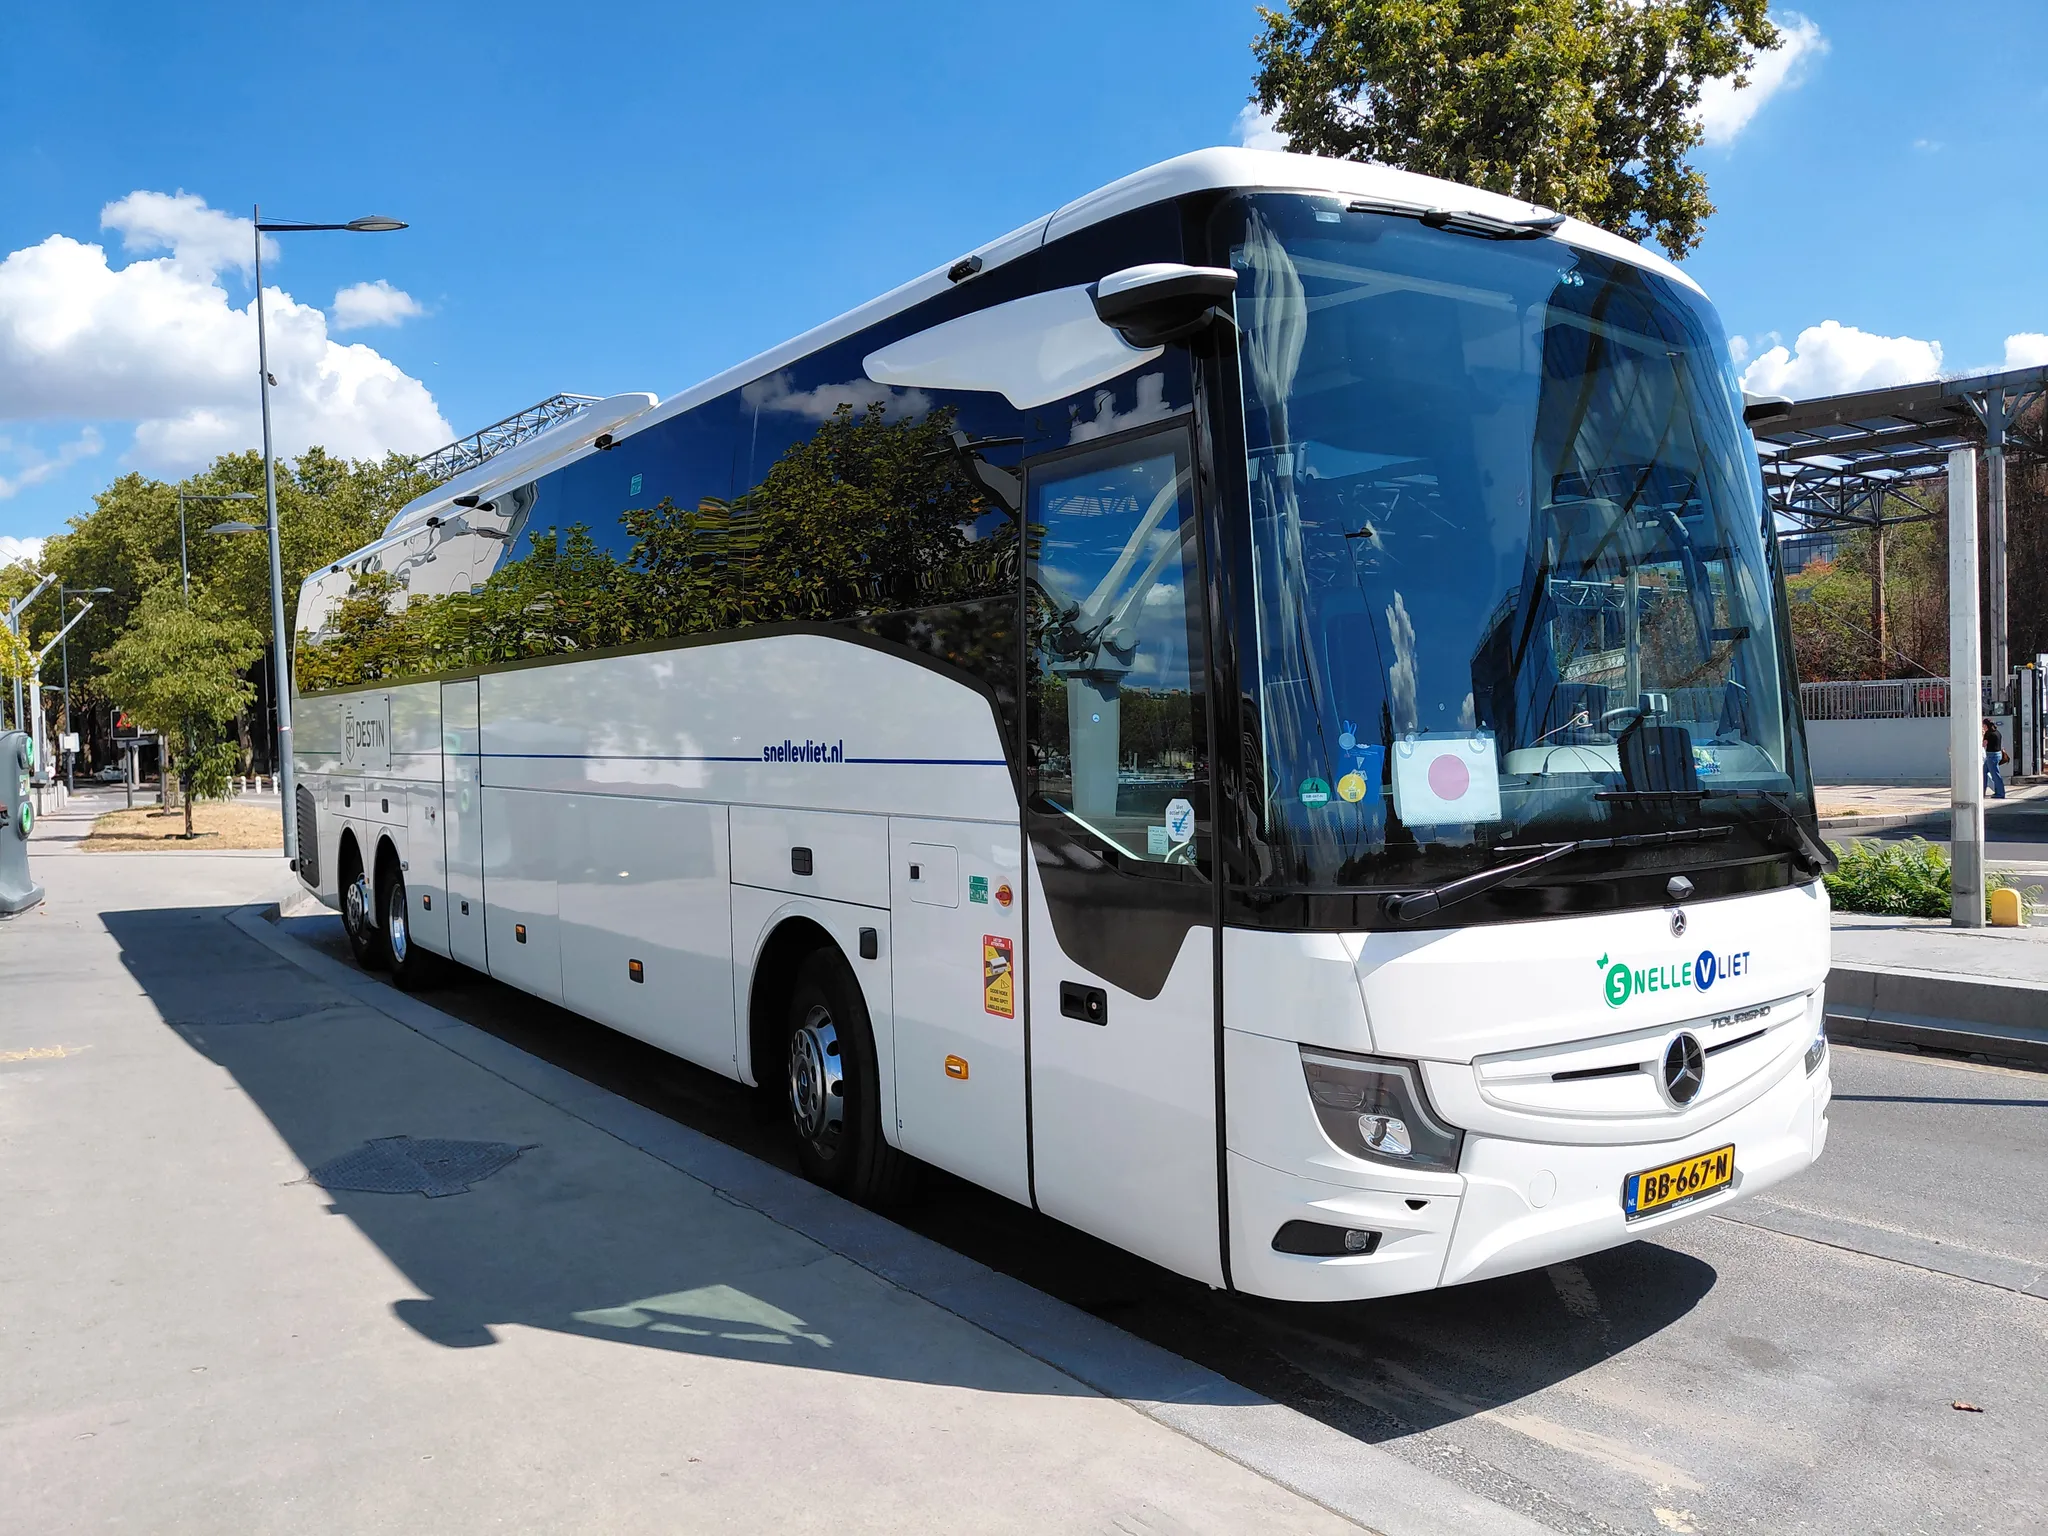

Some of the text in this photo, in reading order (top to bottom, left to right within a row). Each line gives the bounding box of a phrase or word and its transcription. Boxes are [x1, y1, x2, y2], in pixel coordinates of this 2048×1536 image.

[356, 720, 385, 748] DESTIN
[763, 739, 843, 763] snellevliet.nl
[1310, 781, 1320, 793] 4
[1711, 1005, 1771, 1030] TOURISMO
[1644, 1153, 1728, 1204] BB-667-N
[1627, 1198, 1637, 1207] NL
